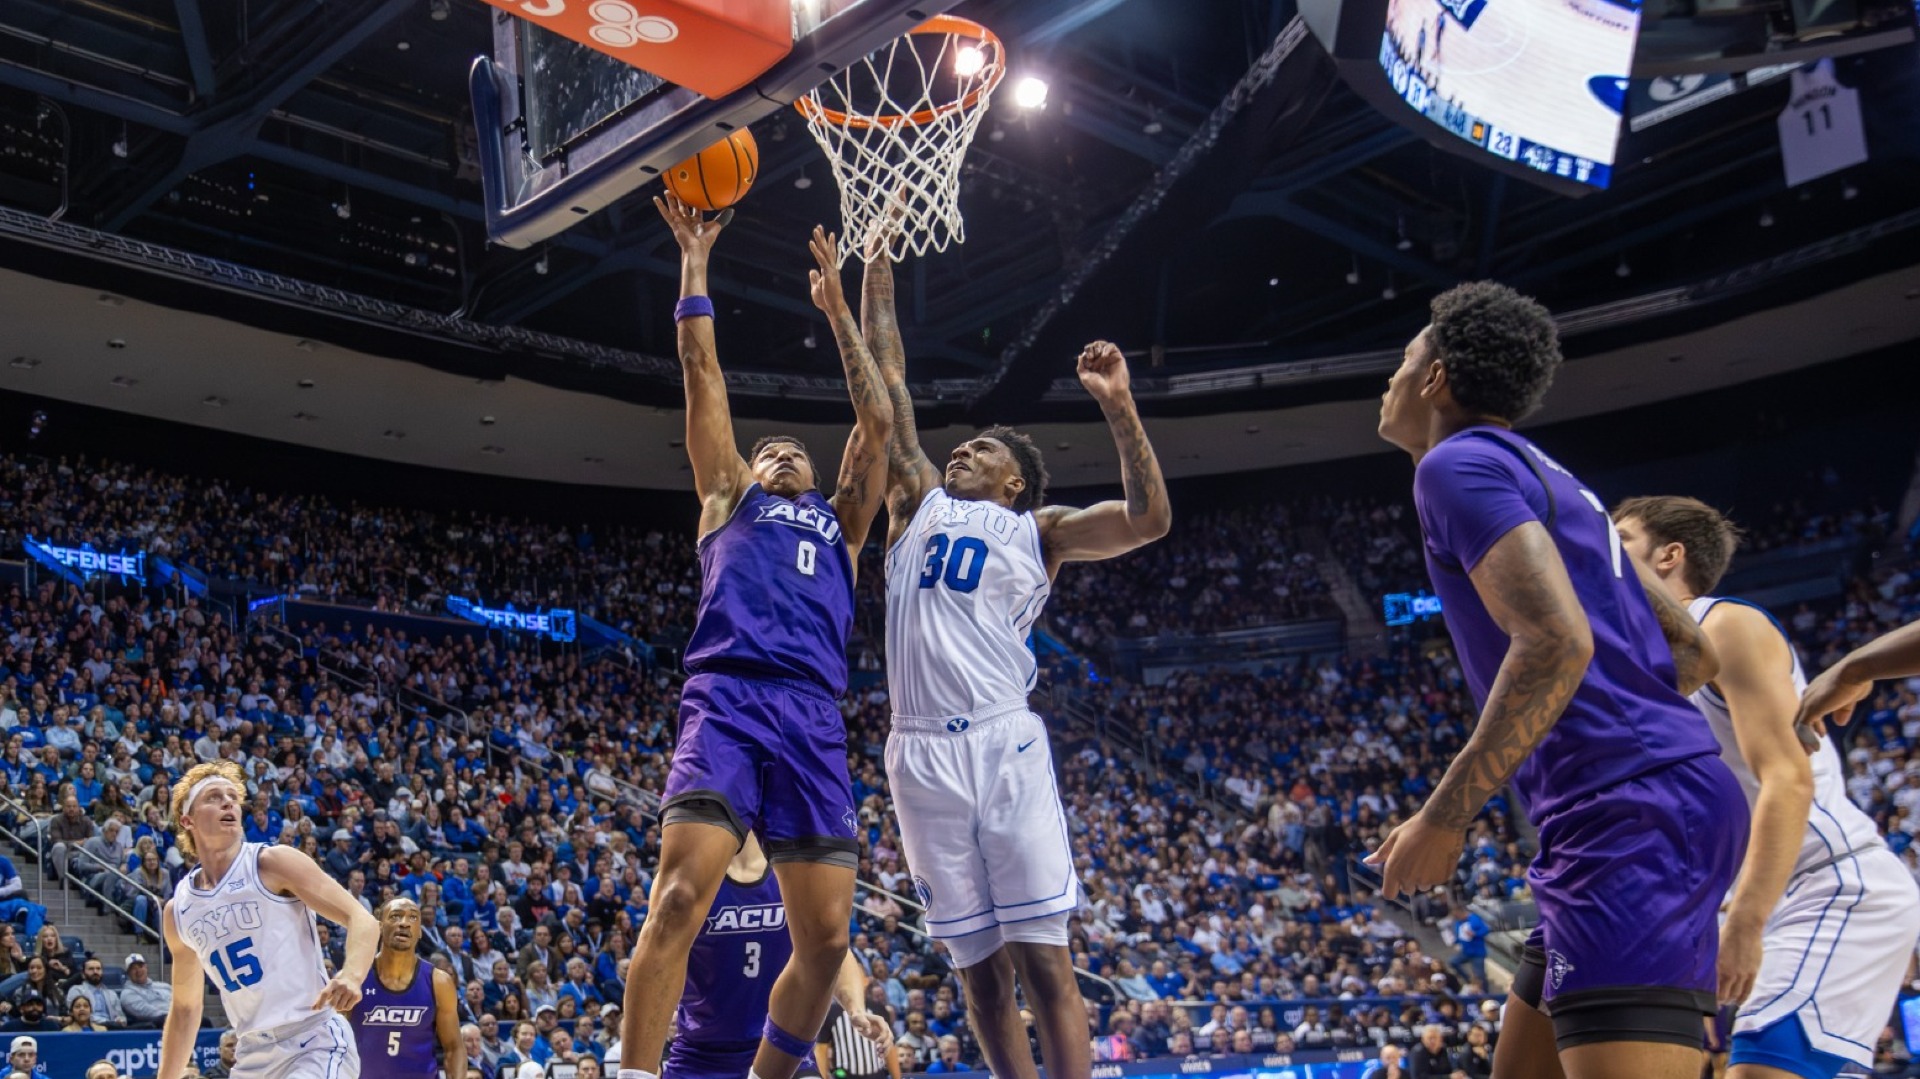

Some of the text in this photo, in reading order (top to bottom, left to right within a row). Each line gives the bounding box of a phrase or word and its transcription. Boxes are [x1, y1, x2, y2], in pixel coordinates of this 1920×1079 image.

[1803, 103, 1832, 136] 11
[766, 503, 839, 538] ACU
[927, 502, 1018, 545] BYU
[796, 540, 816, 576] 0
[919, 533, 990, 594] 30
[187, 900, 262, 951] BYU
[714, 906, 786, 931] ACU
[209, 937, 263, 993] 15
[743, 941, 761, 978] 3
[368, 1004, 424, 1025] ACU
[387, 1031, 401, 1057] 5
